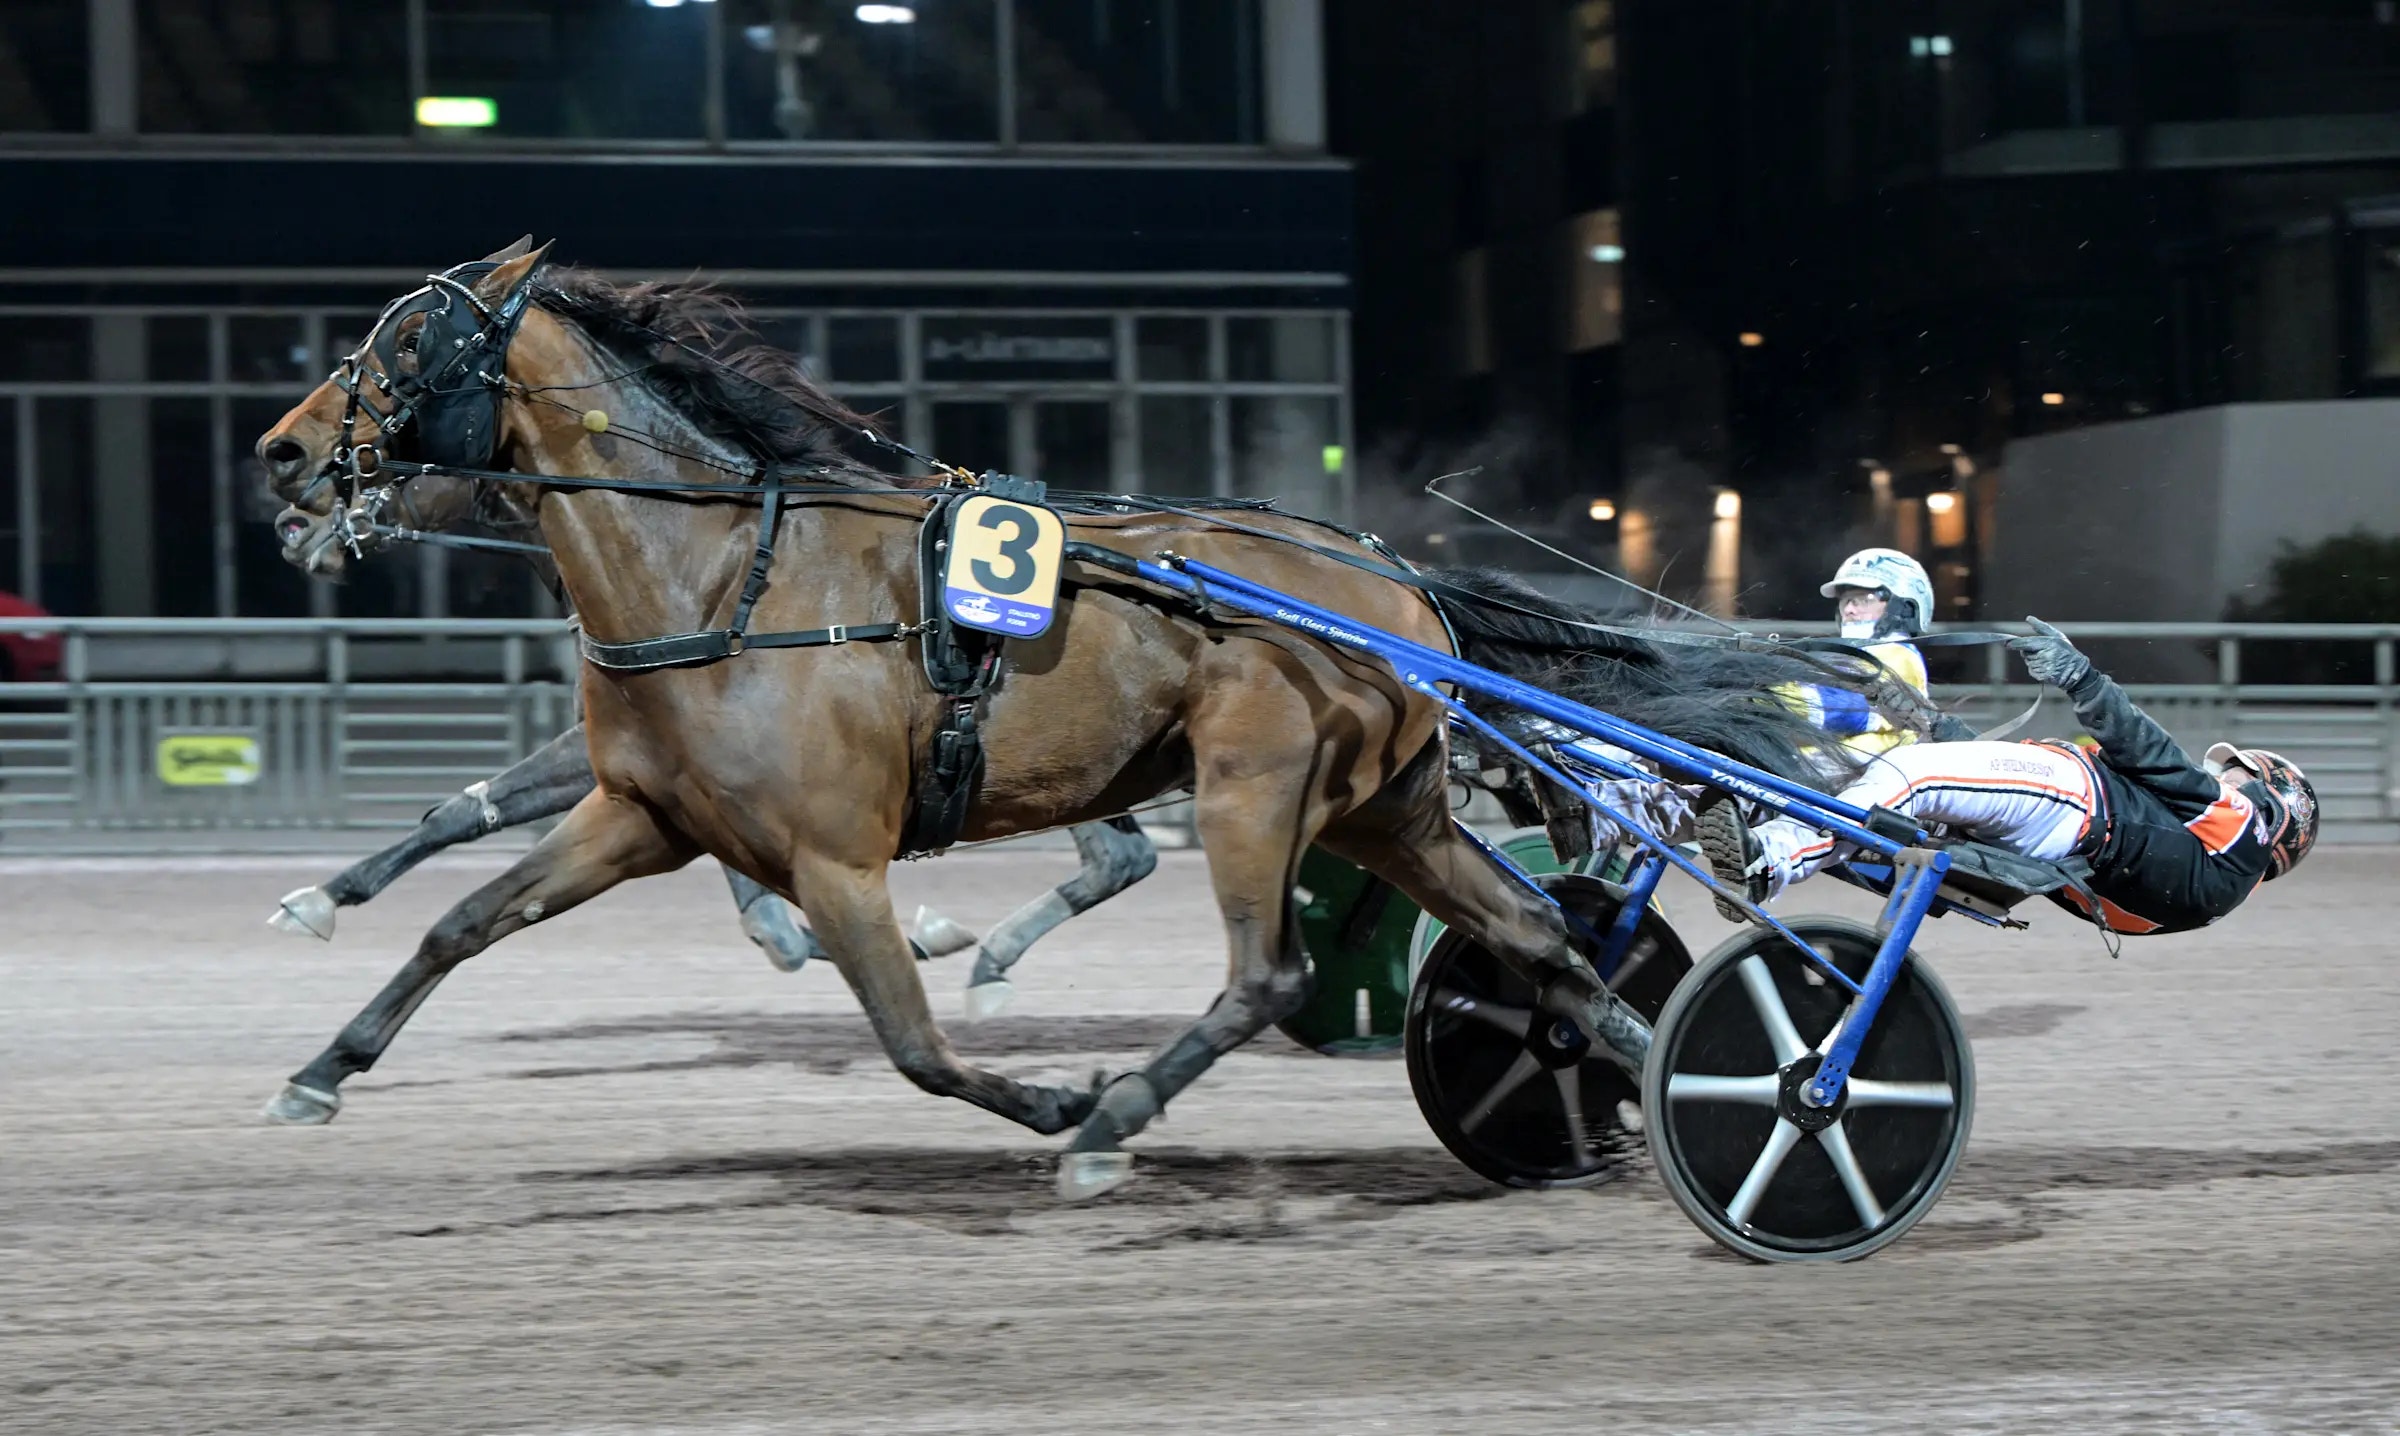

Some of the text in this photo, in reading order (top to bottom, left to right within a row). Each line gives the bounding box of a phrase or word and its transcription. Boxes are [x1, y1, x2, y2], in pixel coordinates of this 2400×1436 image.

[970, 504, 1040, 596] 3
[1275, 608, 1300, 624] Stall
[1710, 768, 1791, 808] YANKEE
